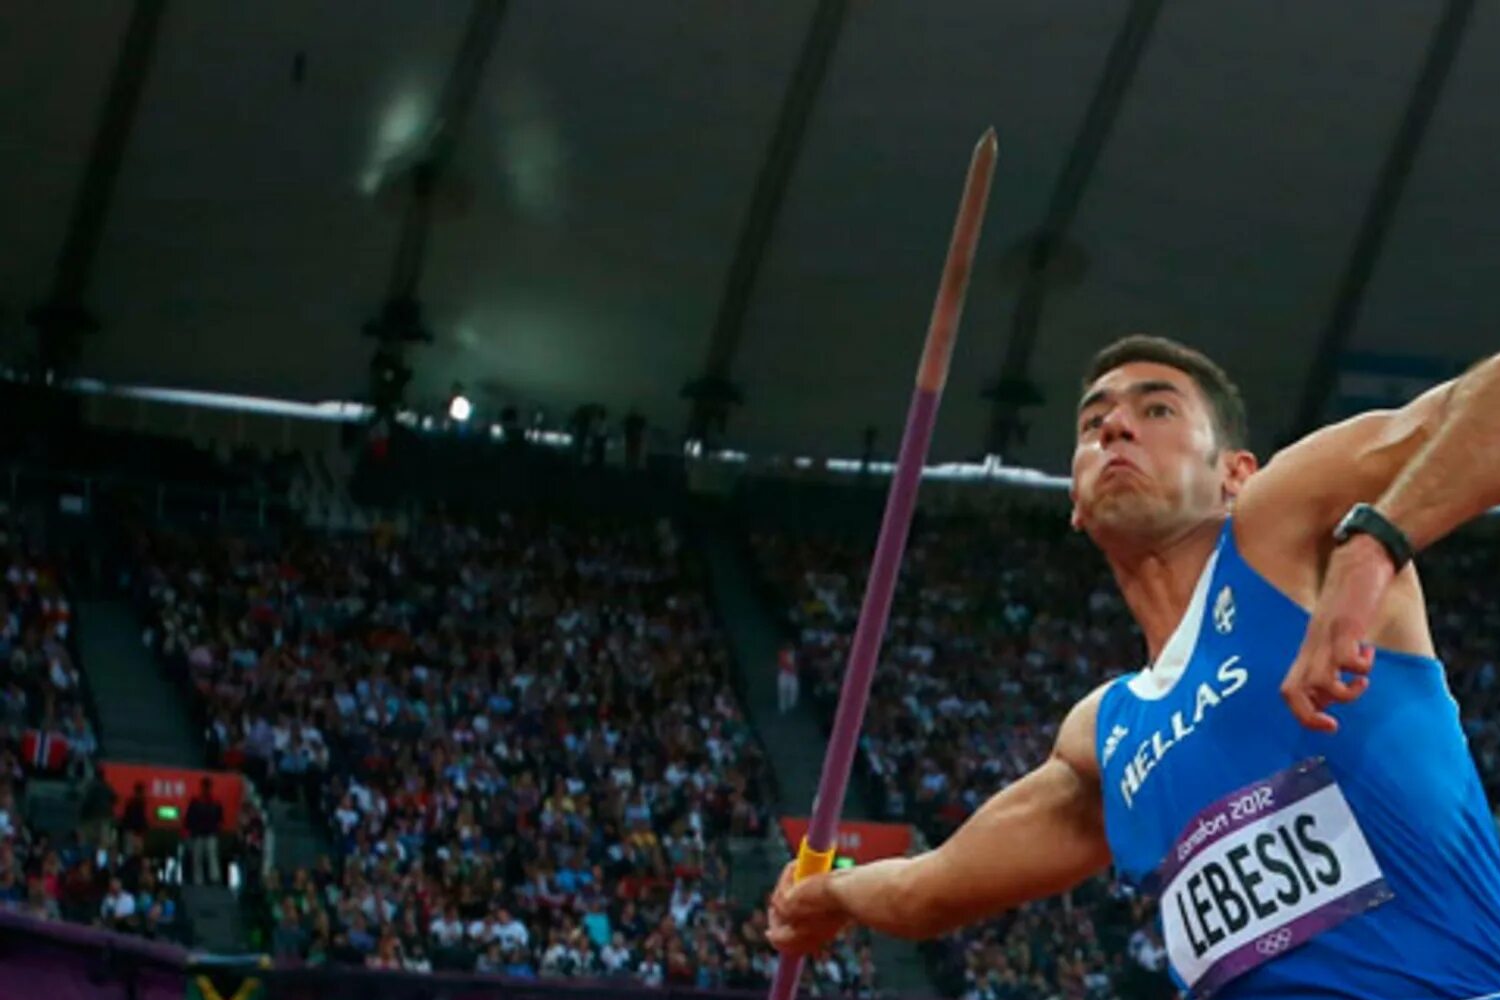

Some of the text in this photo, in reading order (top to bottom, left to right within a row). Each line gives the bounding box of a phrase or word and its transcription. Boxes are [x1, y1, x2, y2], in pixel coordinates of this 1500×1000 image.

[1120, 655, 1249, 809] HELLAS
[1227, 785, 1275, 821] 2012
[1176, 813, 1343, 960] LEBESIS
